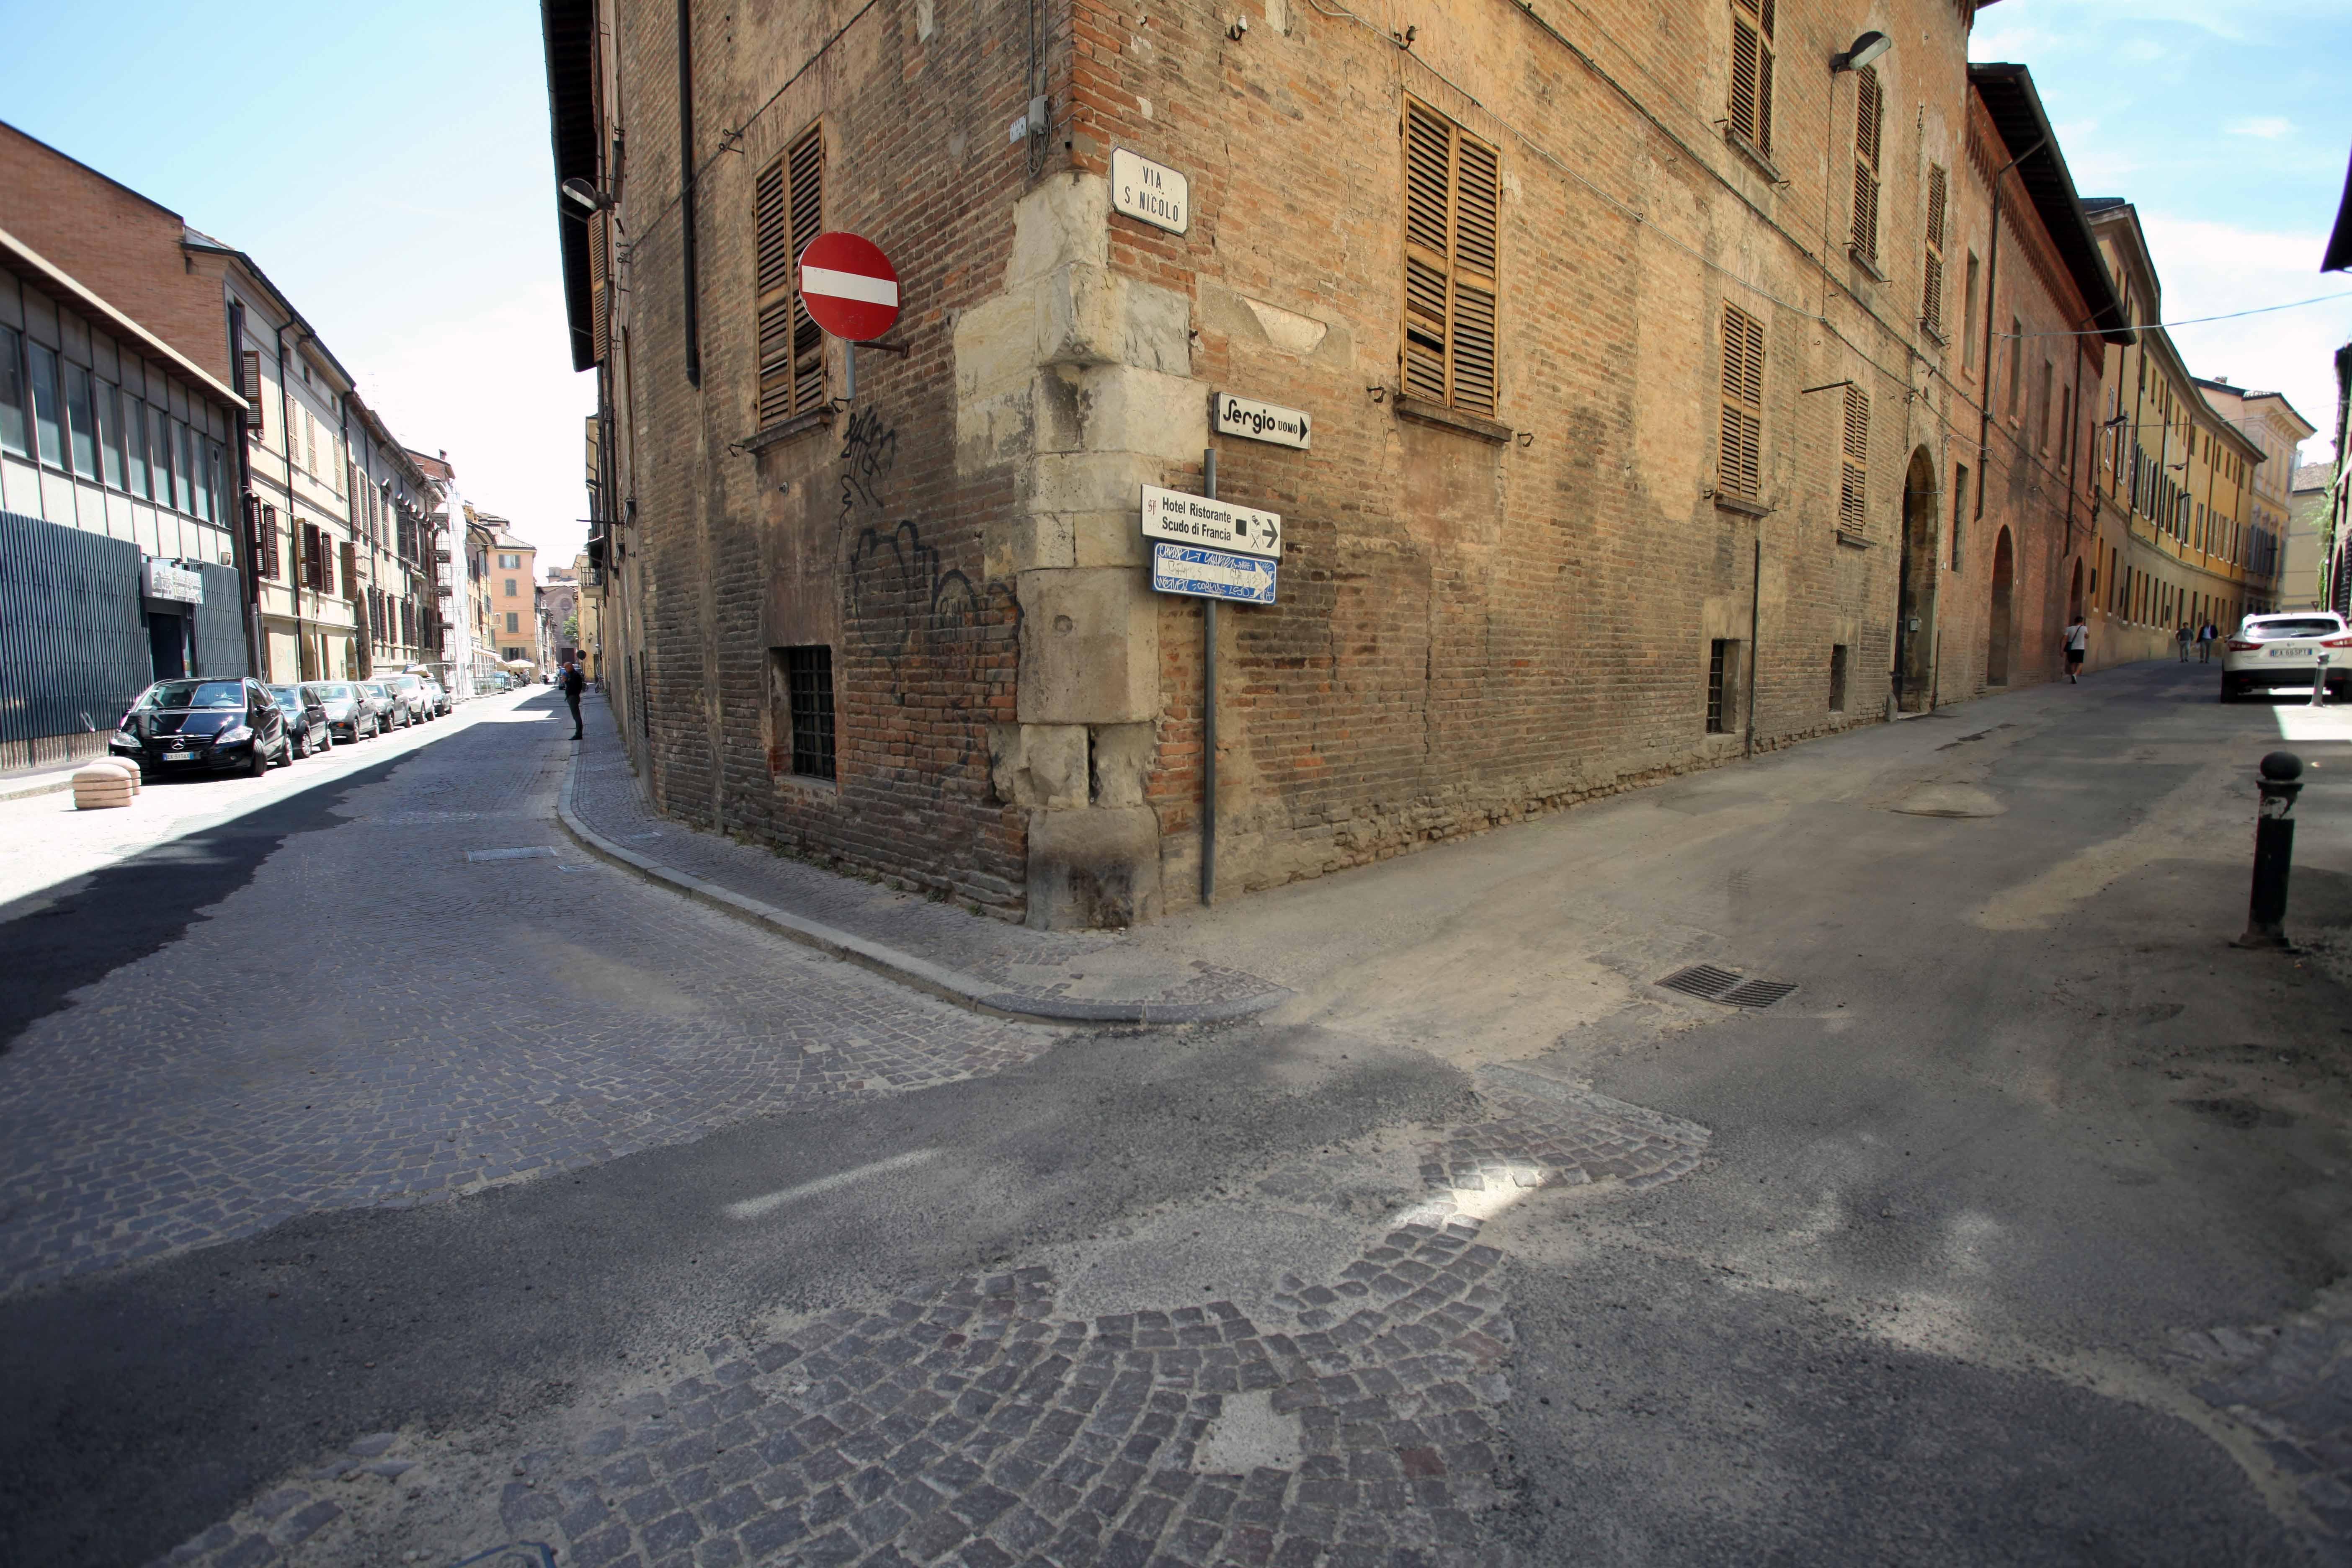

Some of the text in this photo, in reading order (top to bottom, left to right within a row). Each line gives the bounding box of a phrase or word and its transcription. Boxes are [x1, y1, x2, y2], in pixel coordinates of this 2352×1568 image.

[1142, 165, 1161, 189] VIA
[1124, 186, 1133, 206] S.
[1222, 399, 1298, 434] Sergio UOMO
[1162, 496, 1232, 523] Hotel Ristorante
[1162, 516, 1231, 541] Scudo di Francia
